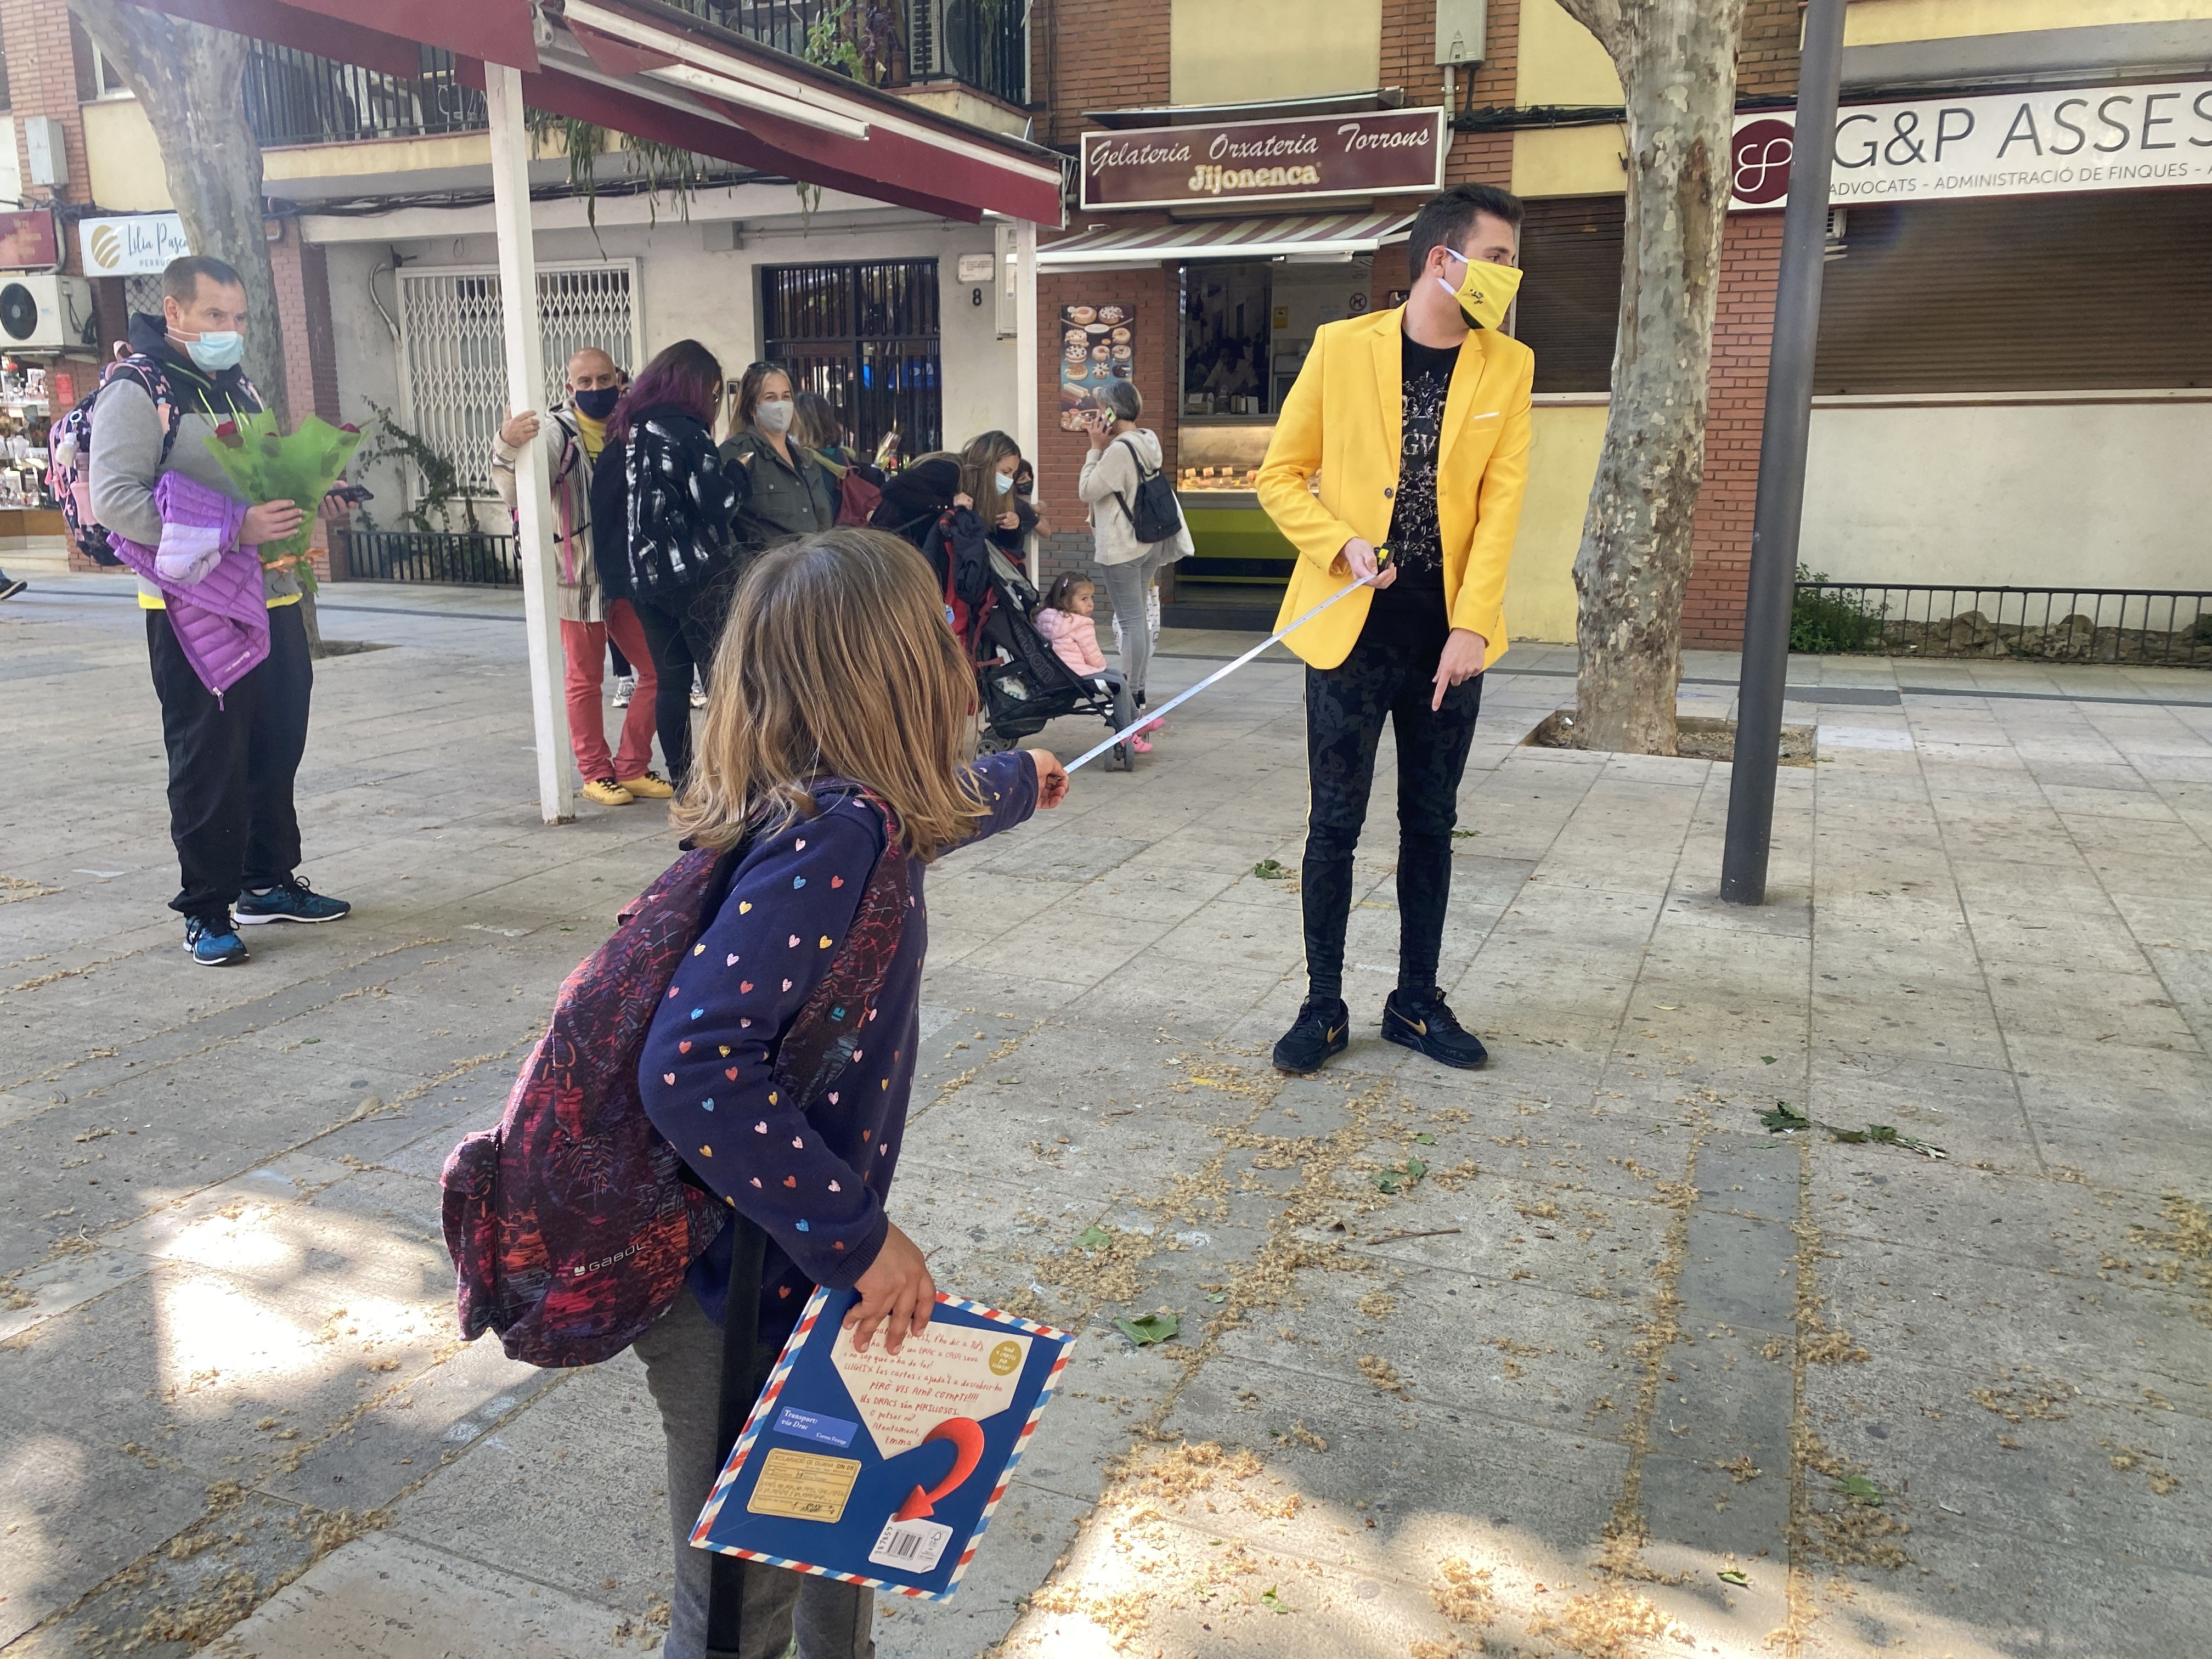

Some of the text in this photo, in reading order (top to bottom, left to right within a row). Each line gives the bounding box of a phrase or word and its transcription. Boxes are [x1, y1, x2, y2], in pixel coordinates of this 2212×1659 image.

[1833, 107, 1976, 168] G&P
[1090, 123, 1430, 176] Gelateria Orxateria Torrons
[1829, 178, 1917, 195] ADVOCATS
[1934, 167, 2074, 190] ADMINISTRACIÓ
[2079, 167, 2103, 181] DE
[2109, 162, 2189, 179] FINQUES
[128, 223, 154, 256] Lilia
[972, 287, 982, 306] 8
[918, 1347, 936, 1357] DRAC
[860, 1354, 872, 1362] sap
[908, 1359, 916, 1367] de
[891, 1371, 915, 1380] cartes
[870, 1379, 893, 1391] PERÒ
[895, 1385, 910, 1394] VES
[873, 1397, 897, 1408] DRACS
[900, 1401, 913, 1409] són
[877, 1412, 901, 1421] potser
[904, 1413, 916, 1422] no?
[872, 1421, 920, 1436] Atentament,
[772, 1455, 806, 1465] DECLARACIÓ
[874, 1526, 893, 1555] 187859
